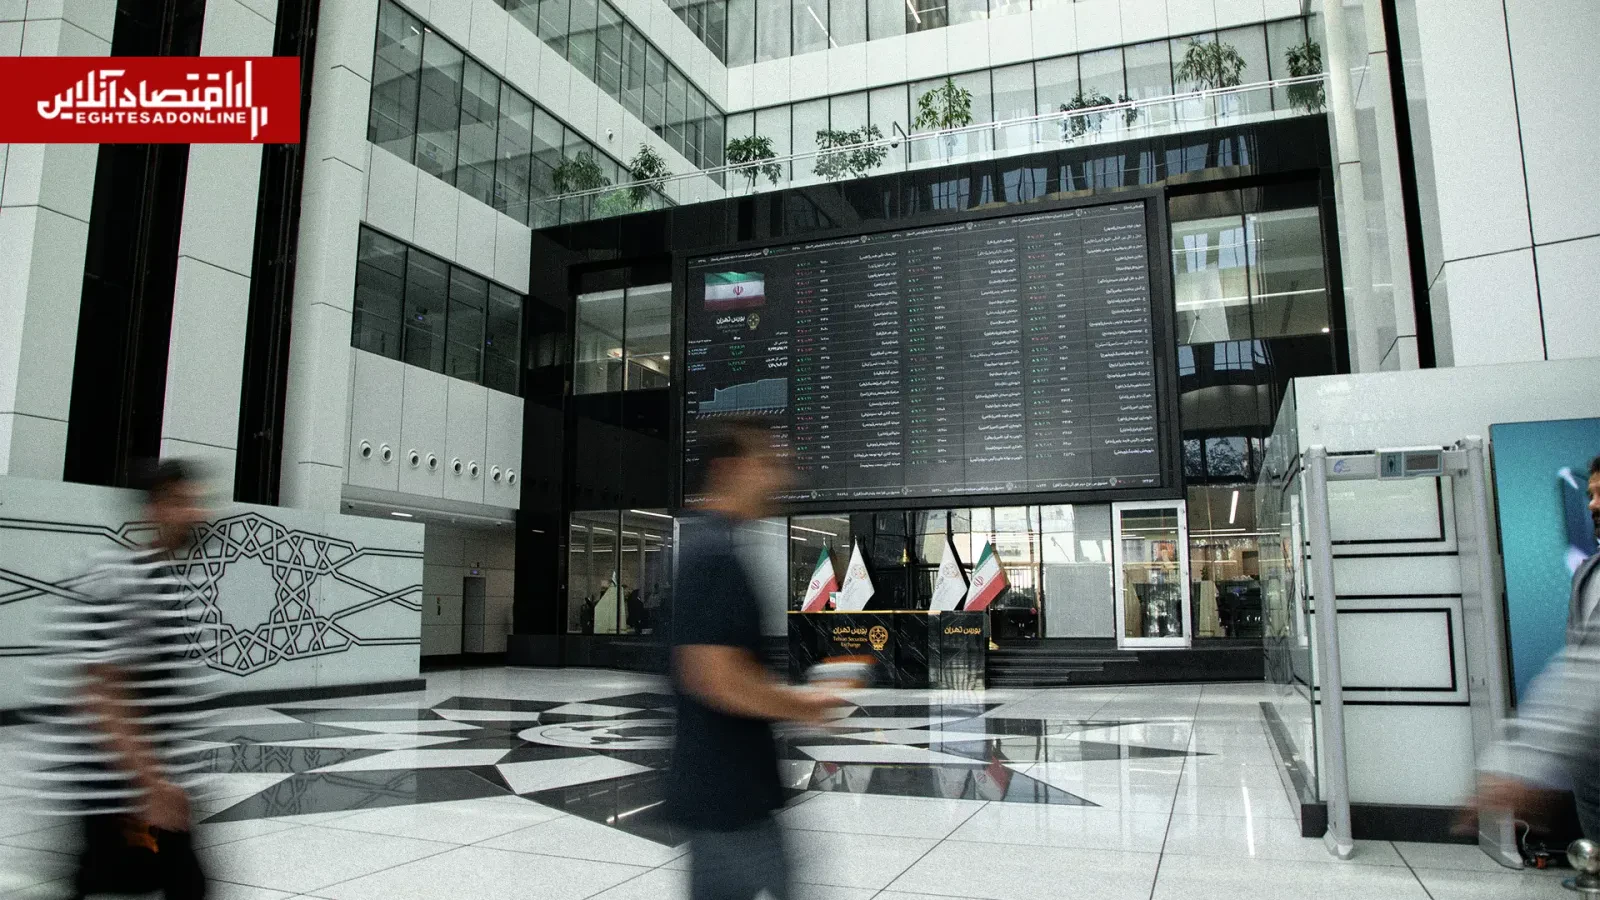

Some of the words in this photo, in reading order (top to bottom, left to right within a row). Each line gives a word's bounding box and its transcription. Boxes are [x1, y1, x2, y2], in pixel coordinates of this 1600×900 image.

[833, 626, 850, 635] تهران
[944, 626, 963, 635] تهران
[963, 627, 981, 635] بورس
